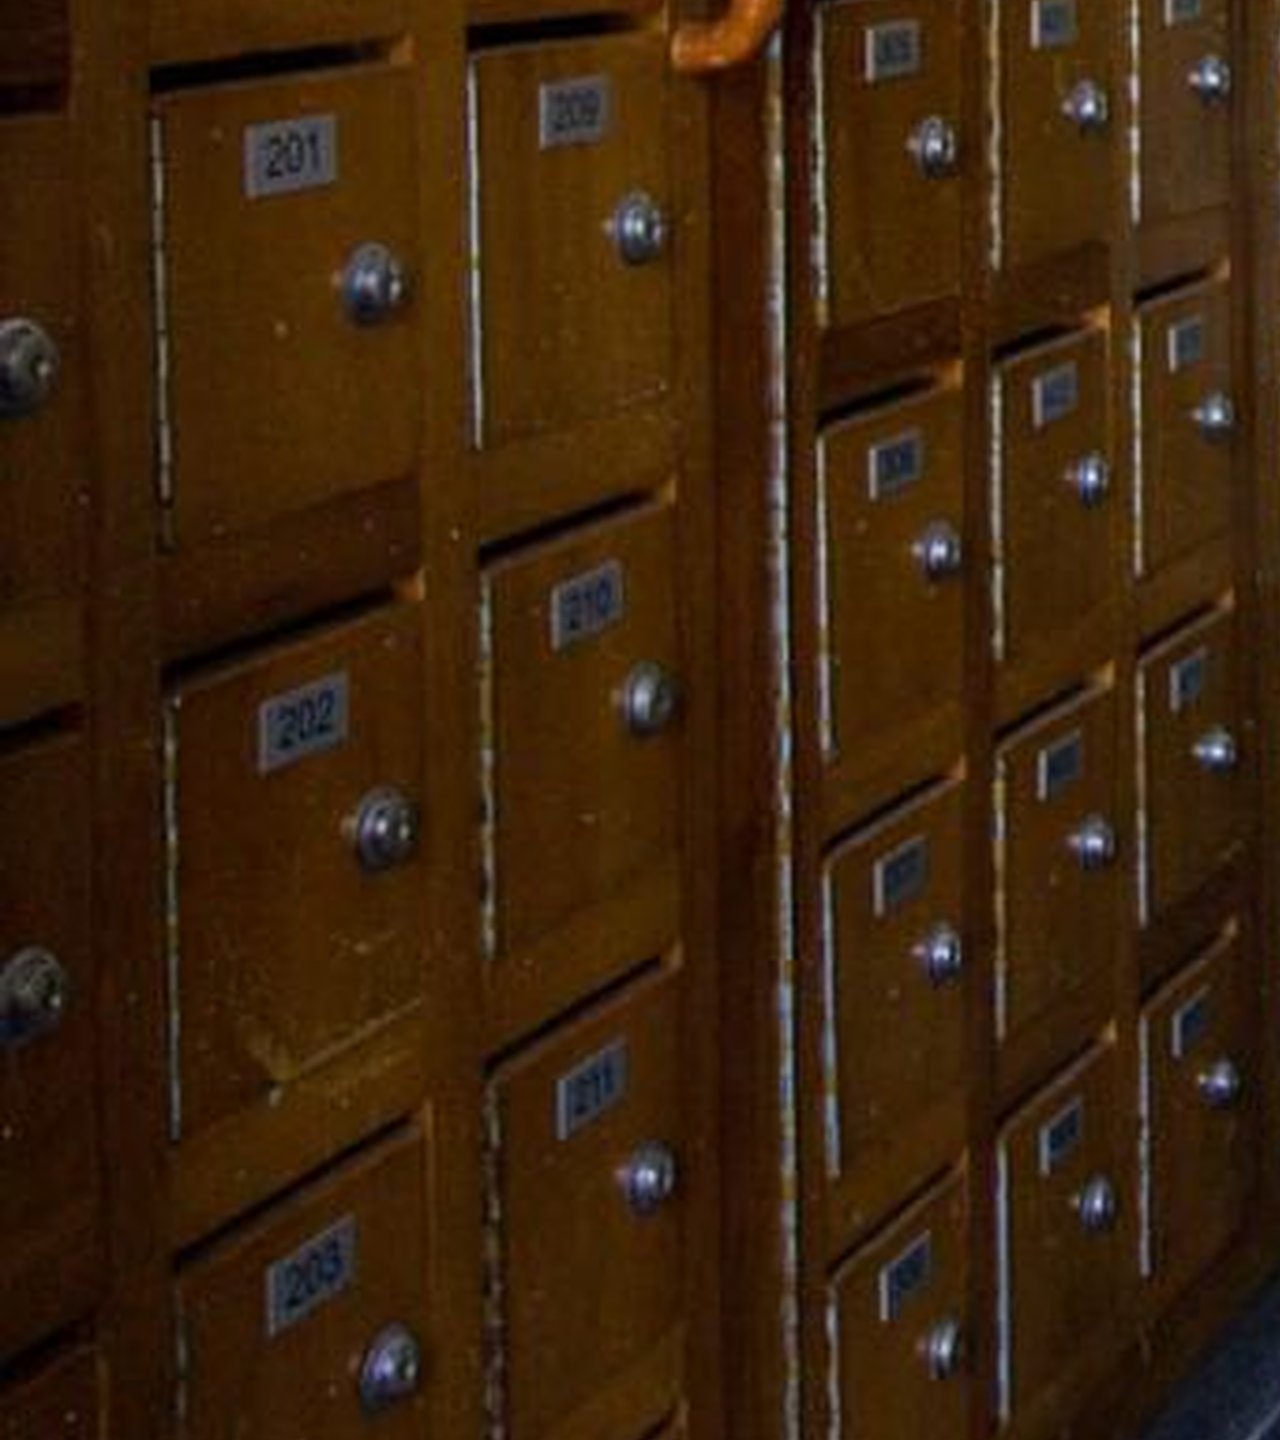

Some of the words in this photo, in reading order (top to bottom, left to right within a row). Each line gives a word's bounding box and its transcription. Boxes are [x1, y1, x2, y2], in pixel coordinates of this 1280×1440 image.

[265, 131, 318, 178] 201
[277, 697, 334, 749] 202
[286, 1238, 341, 1308] 203
